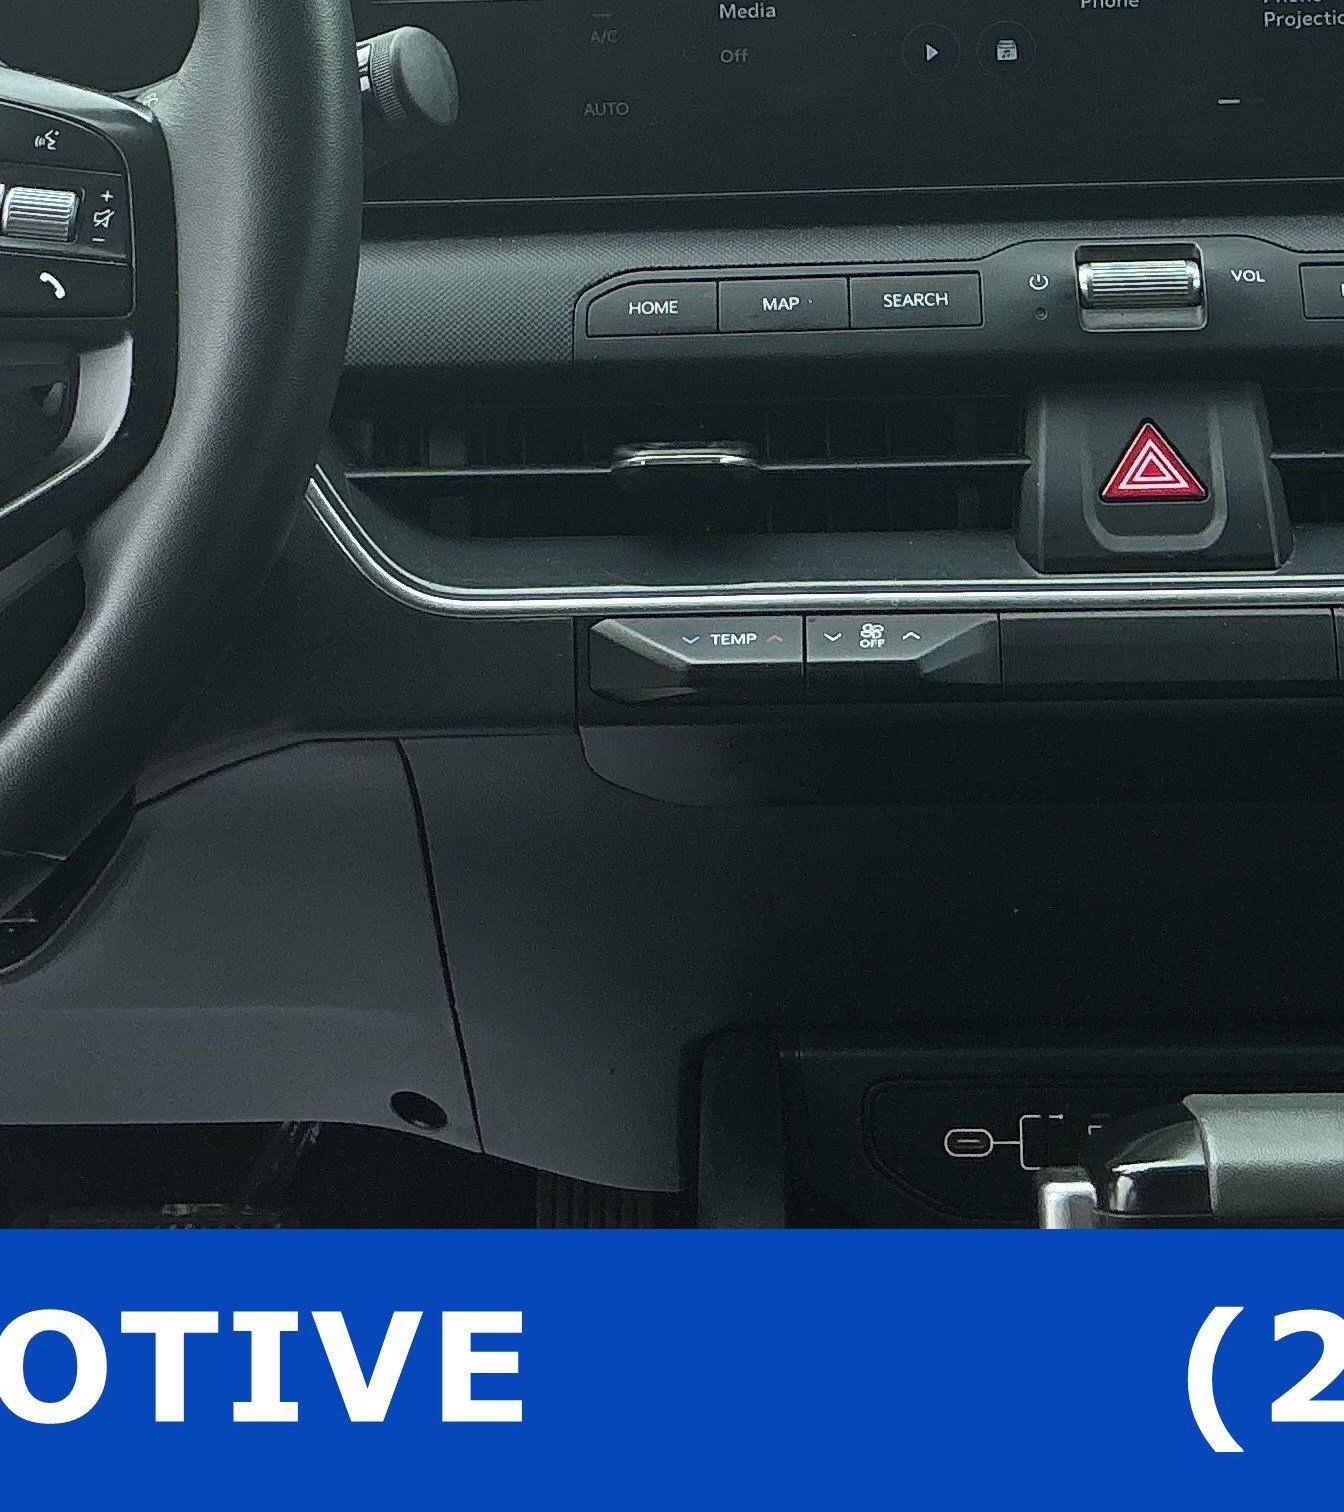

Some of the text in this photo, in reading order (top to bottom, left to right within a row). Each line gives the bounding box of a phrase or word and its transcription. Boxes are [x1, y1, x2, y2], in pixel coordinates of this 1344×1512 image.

[720, 3, 775, 18] Media
[589, 29, 619, 45] A/C
[721, 49, 747, 63] Off
[584, 102, 629, 115] AUTO
[1231, 270, 1265, 282] VOL
[763, 297, 799, 310] MAP
[884, 293, 948, 307] SEARCH
[629, 301, 677, 314] HOME
[711, 634, 756, 645] TEMP
[860, 637, 884, 647] OFF
